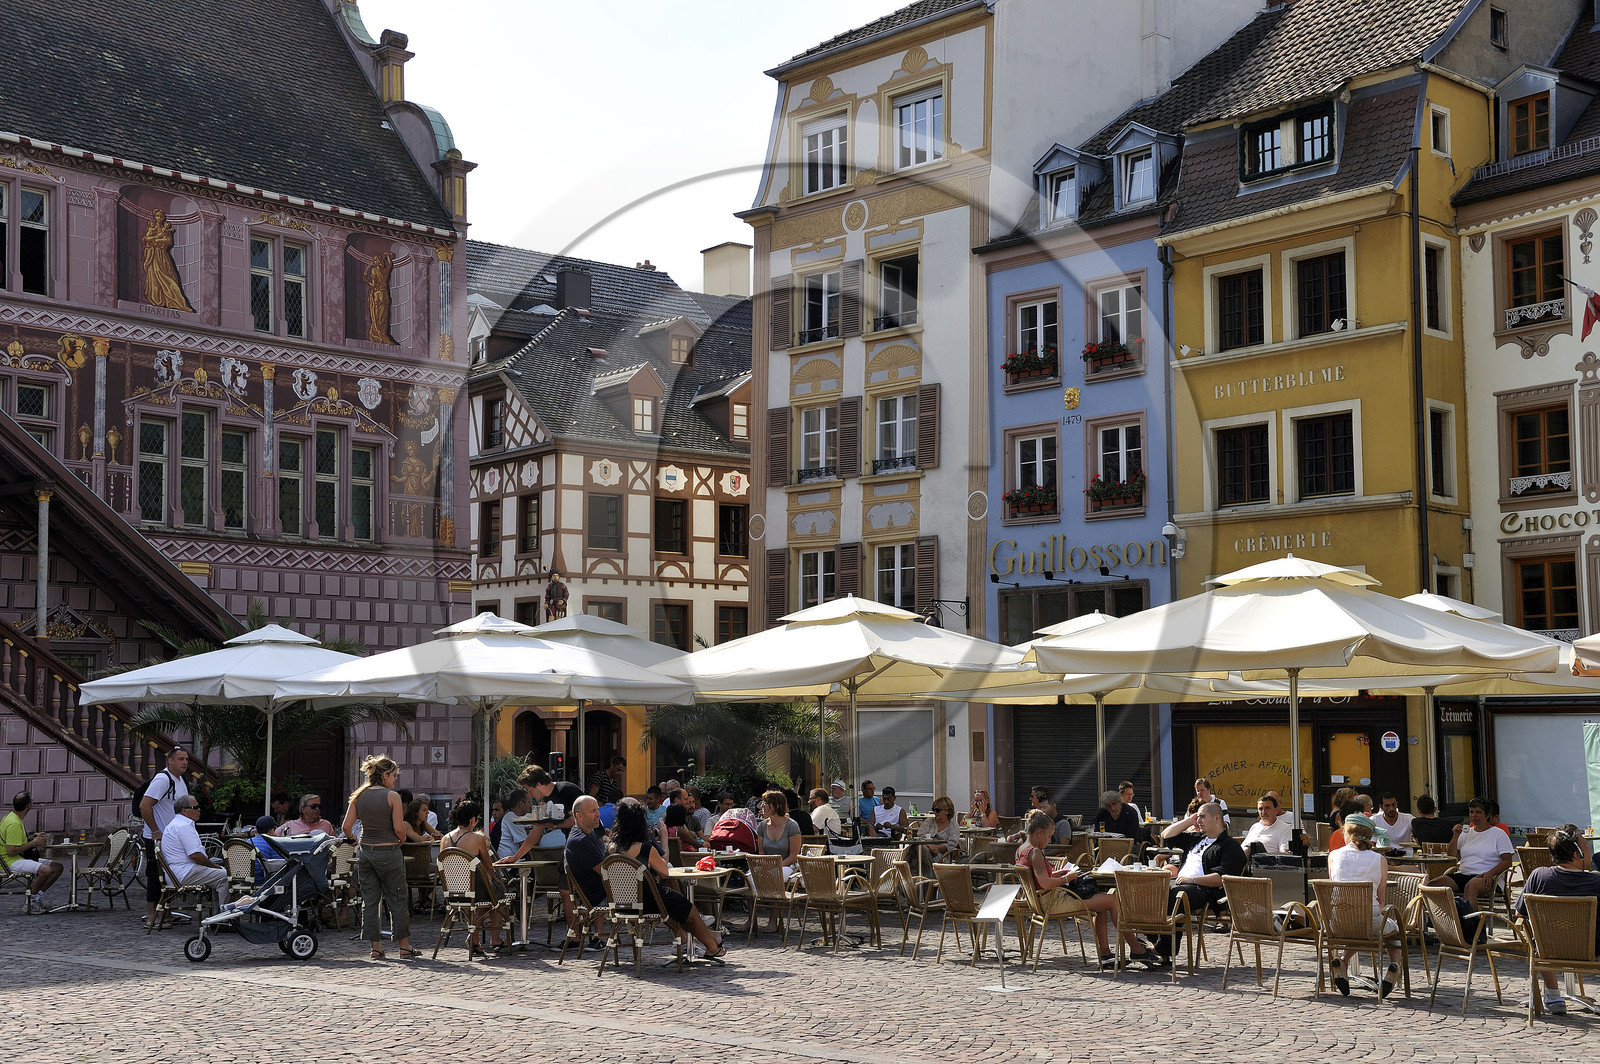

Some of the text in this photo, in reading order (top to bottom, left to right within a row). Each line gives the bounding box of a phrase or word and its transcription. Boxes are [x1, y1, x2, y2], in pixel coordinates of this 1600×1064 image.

[139, 304, 181, 320] CHARITAS
[1214, 365, 1345, 399] BUTTERBLUME
[1062, 414, 1082, 426] 1479
[1234, 531, 1331, 553] CRÊMERIE
[988, 533, 1168, 577] Guillosson
[1202, 760, 1247, 779] REMIER
[1257, 760, 1310, 787] AFFINER
[1228, 783, 1274, 797] Bouto
